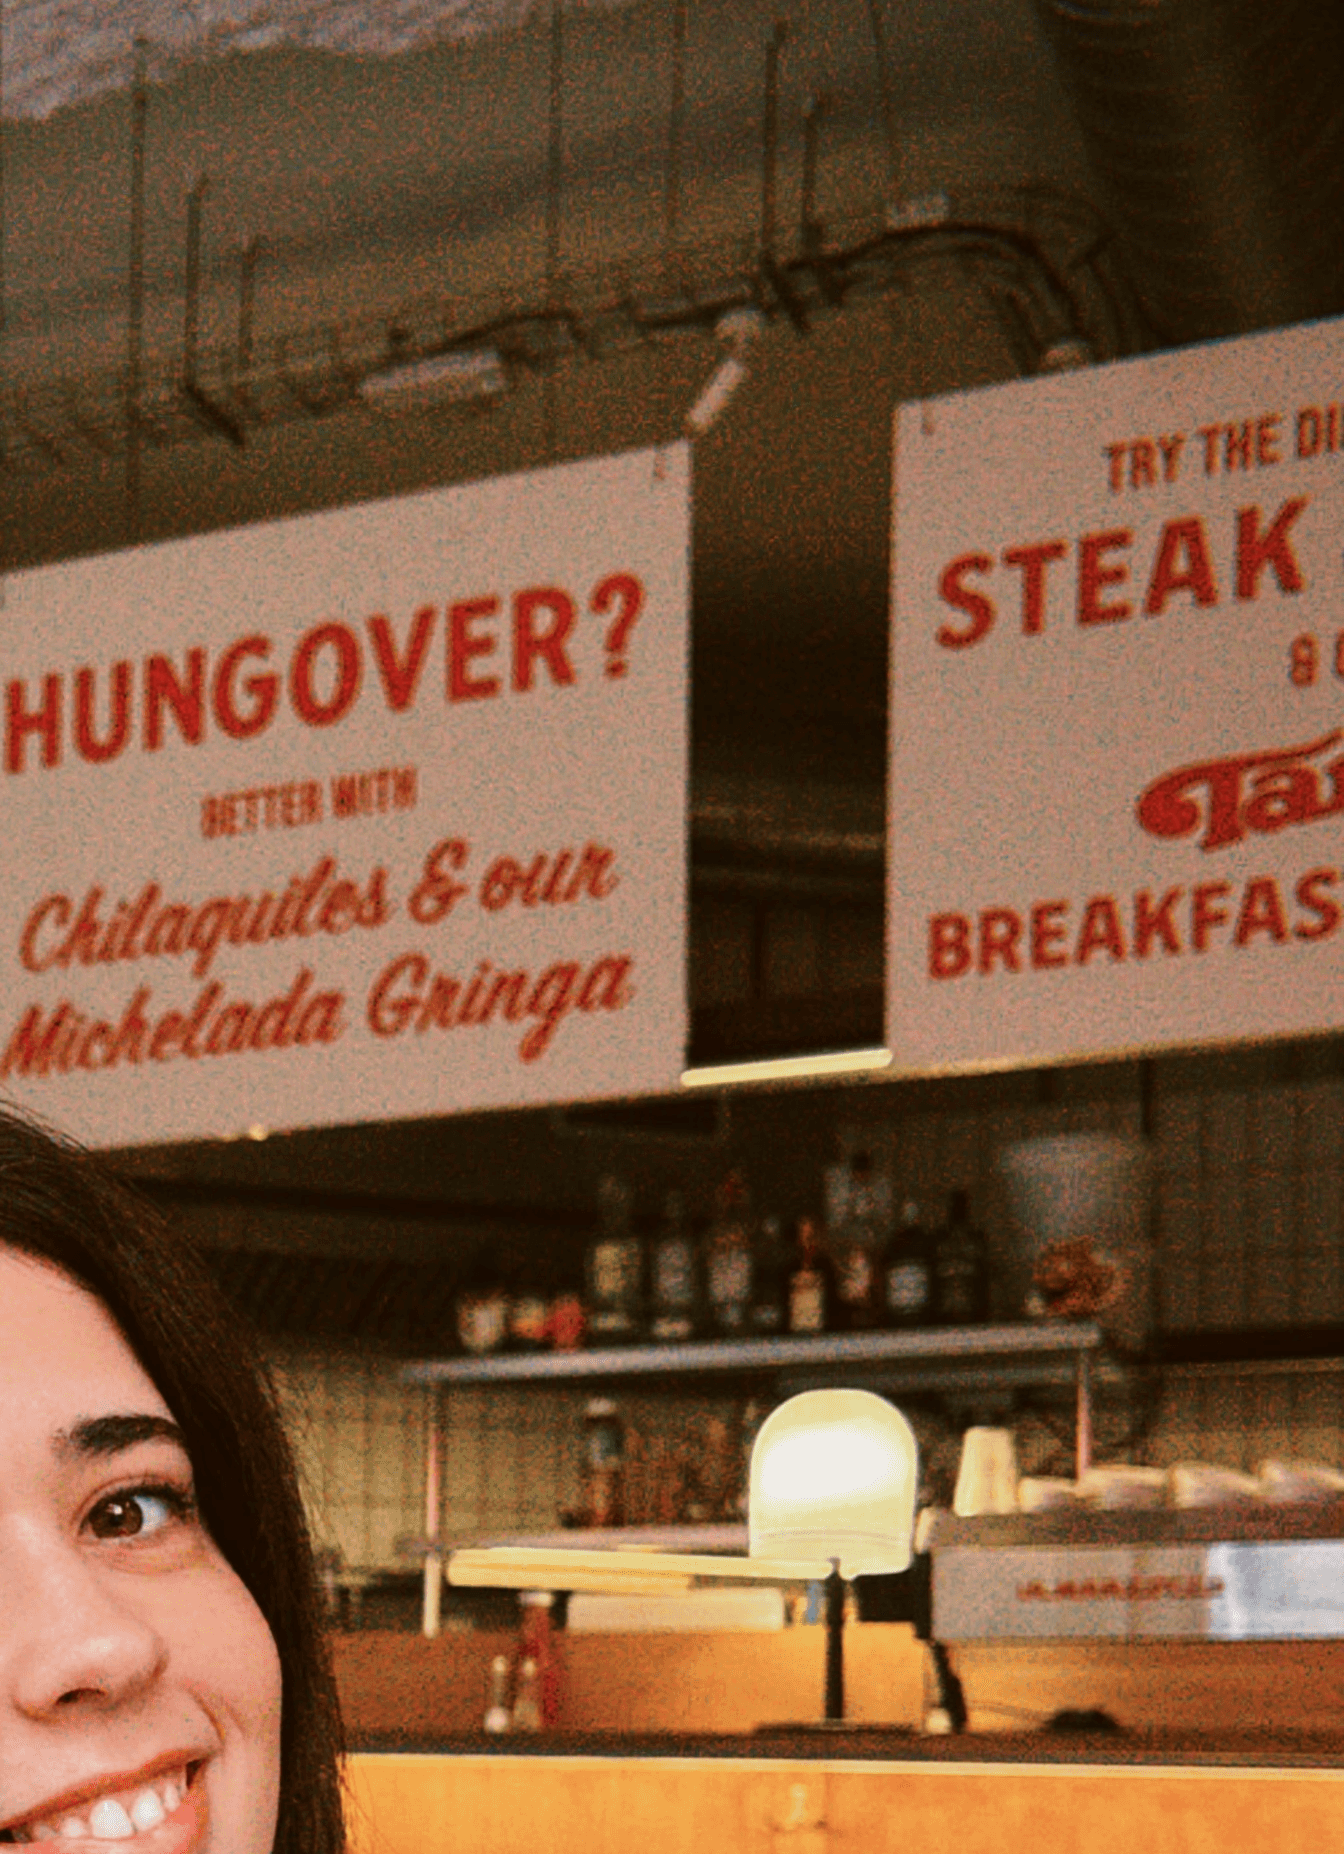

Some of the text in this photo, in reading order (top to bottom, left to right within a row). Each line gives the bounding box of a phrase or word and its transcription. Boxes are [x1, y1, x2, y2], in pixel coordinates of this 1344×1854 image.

[1106, 403, 1344, 496] TRY THE DI
[935, 494, 1312, 652] STEAK
[2, 572, 647, 777] HUNGOVER?
[200, 763, 419, 840] BETTER WITH
[18, 837, 622, 979] Chilaquiles & our
[926, 867, 1344, 981] BREAKFAS
[366, 951, 637, 1064] Gringa
